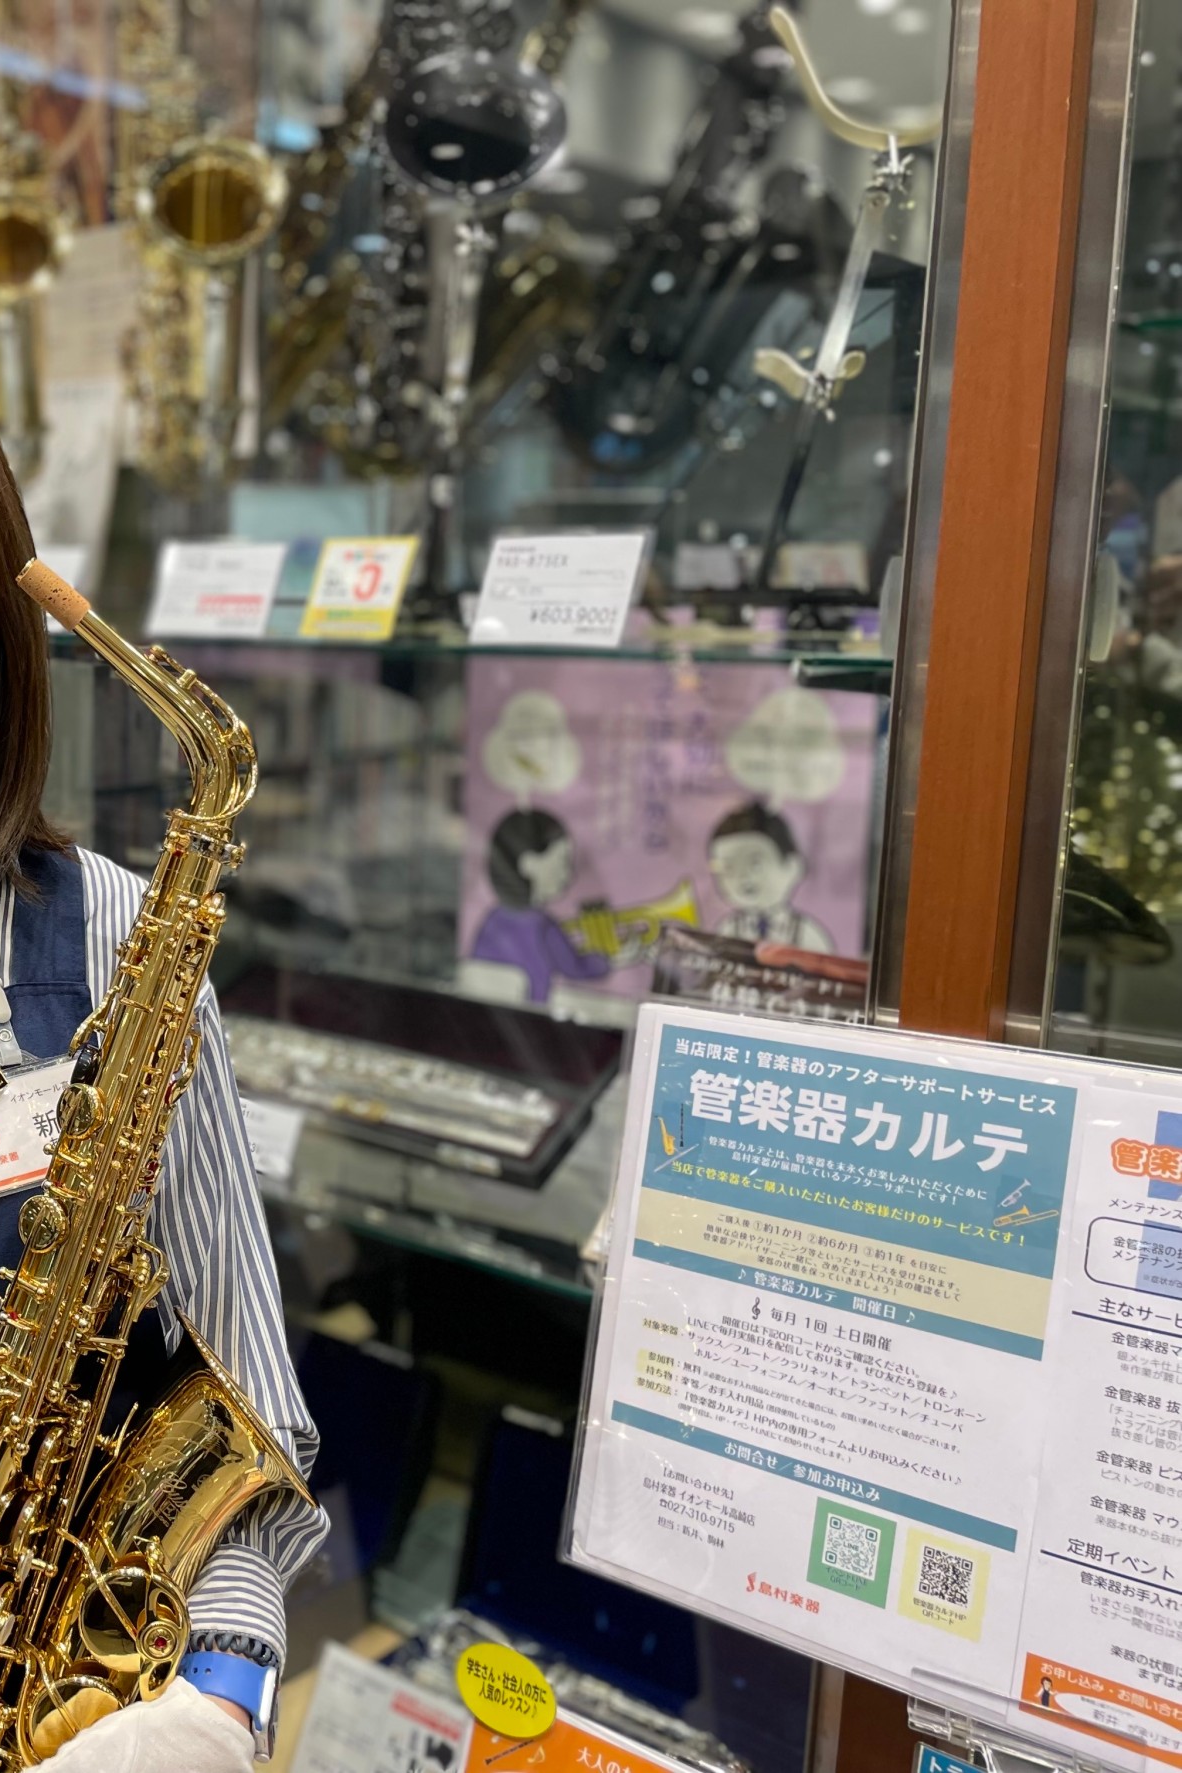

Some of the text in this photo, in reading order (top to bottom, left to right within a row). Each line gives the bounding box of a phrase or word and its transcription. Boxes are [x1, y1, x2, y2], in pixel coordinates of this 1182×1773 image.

[689, 1068, 1028, 1173] 管楽器カルテ
[753, 1270, 897, 1320] 管楽器カルテ 開催日
[771, 1307, 797, 1326] 毎月
[834, 1324, 893, 1352] 土日開催
[1104, 1385, 1161, 1410] 金管楽器
[1109, 1403, 1182, 1430] 「チューニング
[1114, 1418, 1182, 1442] トラブルは管
[1095, 1449, 1153, 1476] 金管楽器
[1089, 1495, 1182, 1531] 金管楽器 マウ
[1066, 1537, 1175, 1581] 定期イベント
[758, 1581, 820, 1614] 島村楽器
[1080, 1571, 1182, 1612] 管楽器お手入れ
[1090, 1593, 1182, 1629] いまさら聞けない
[575, 1746, 634, 1773] 大人の
